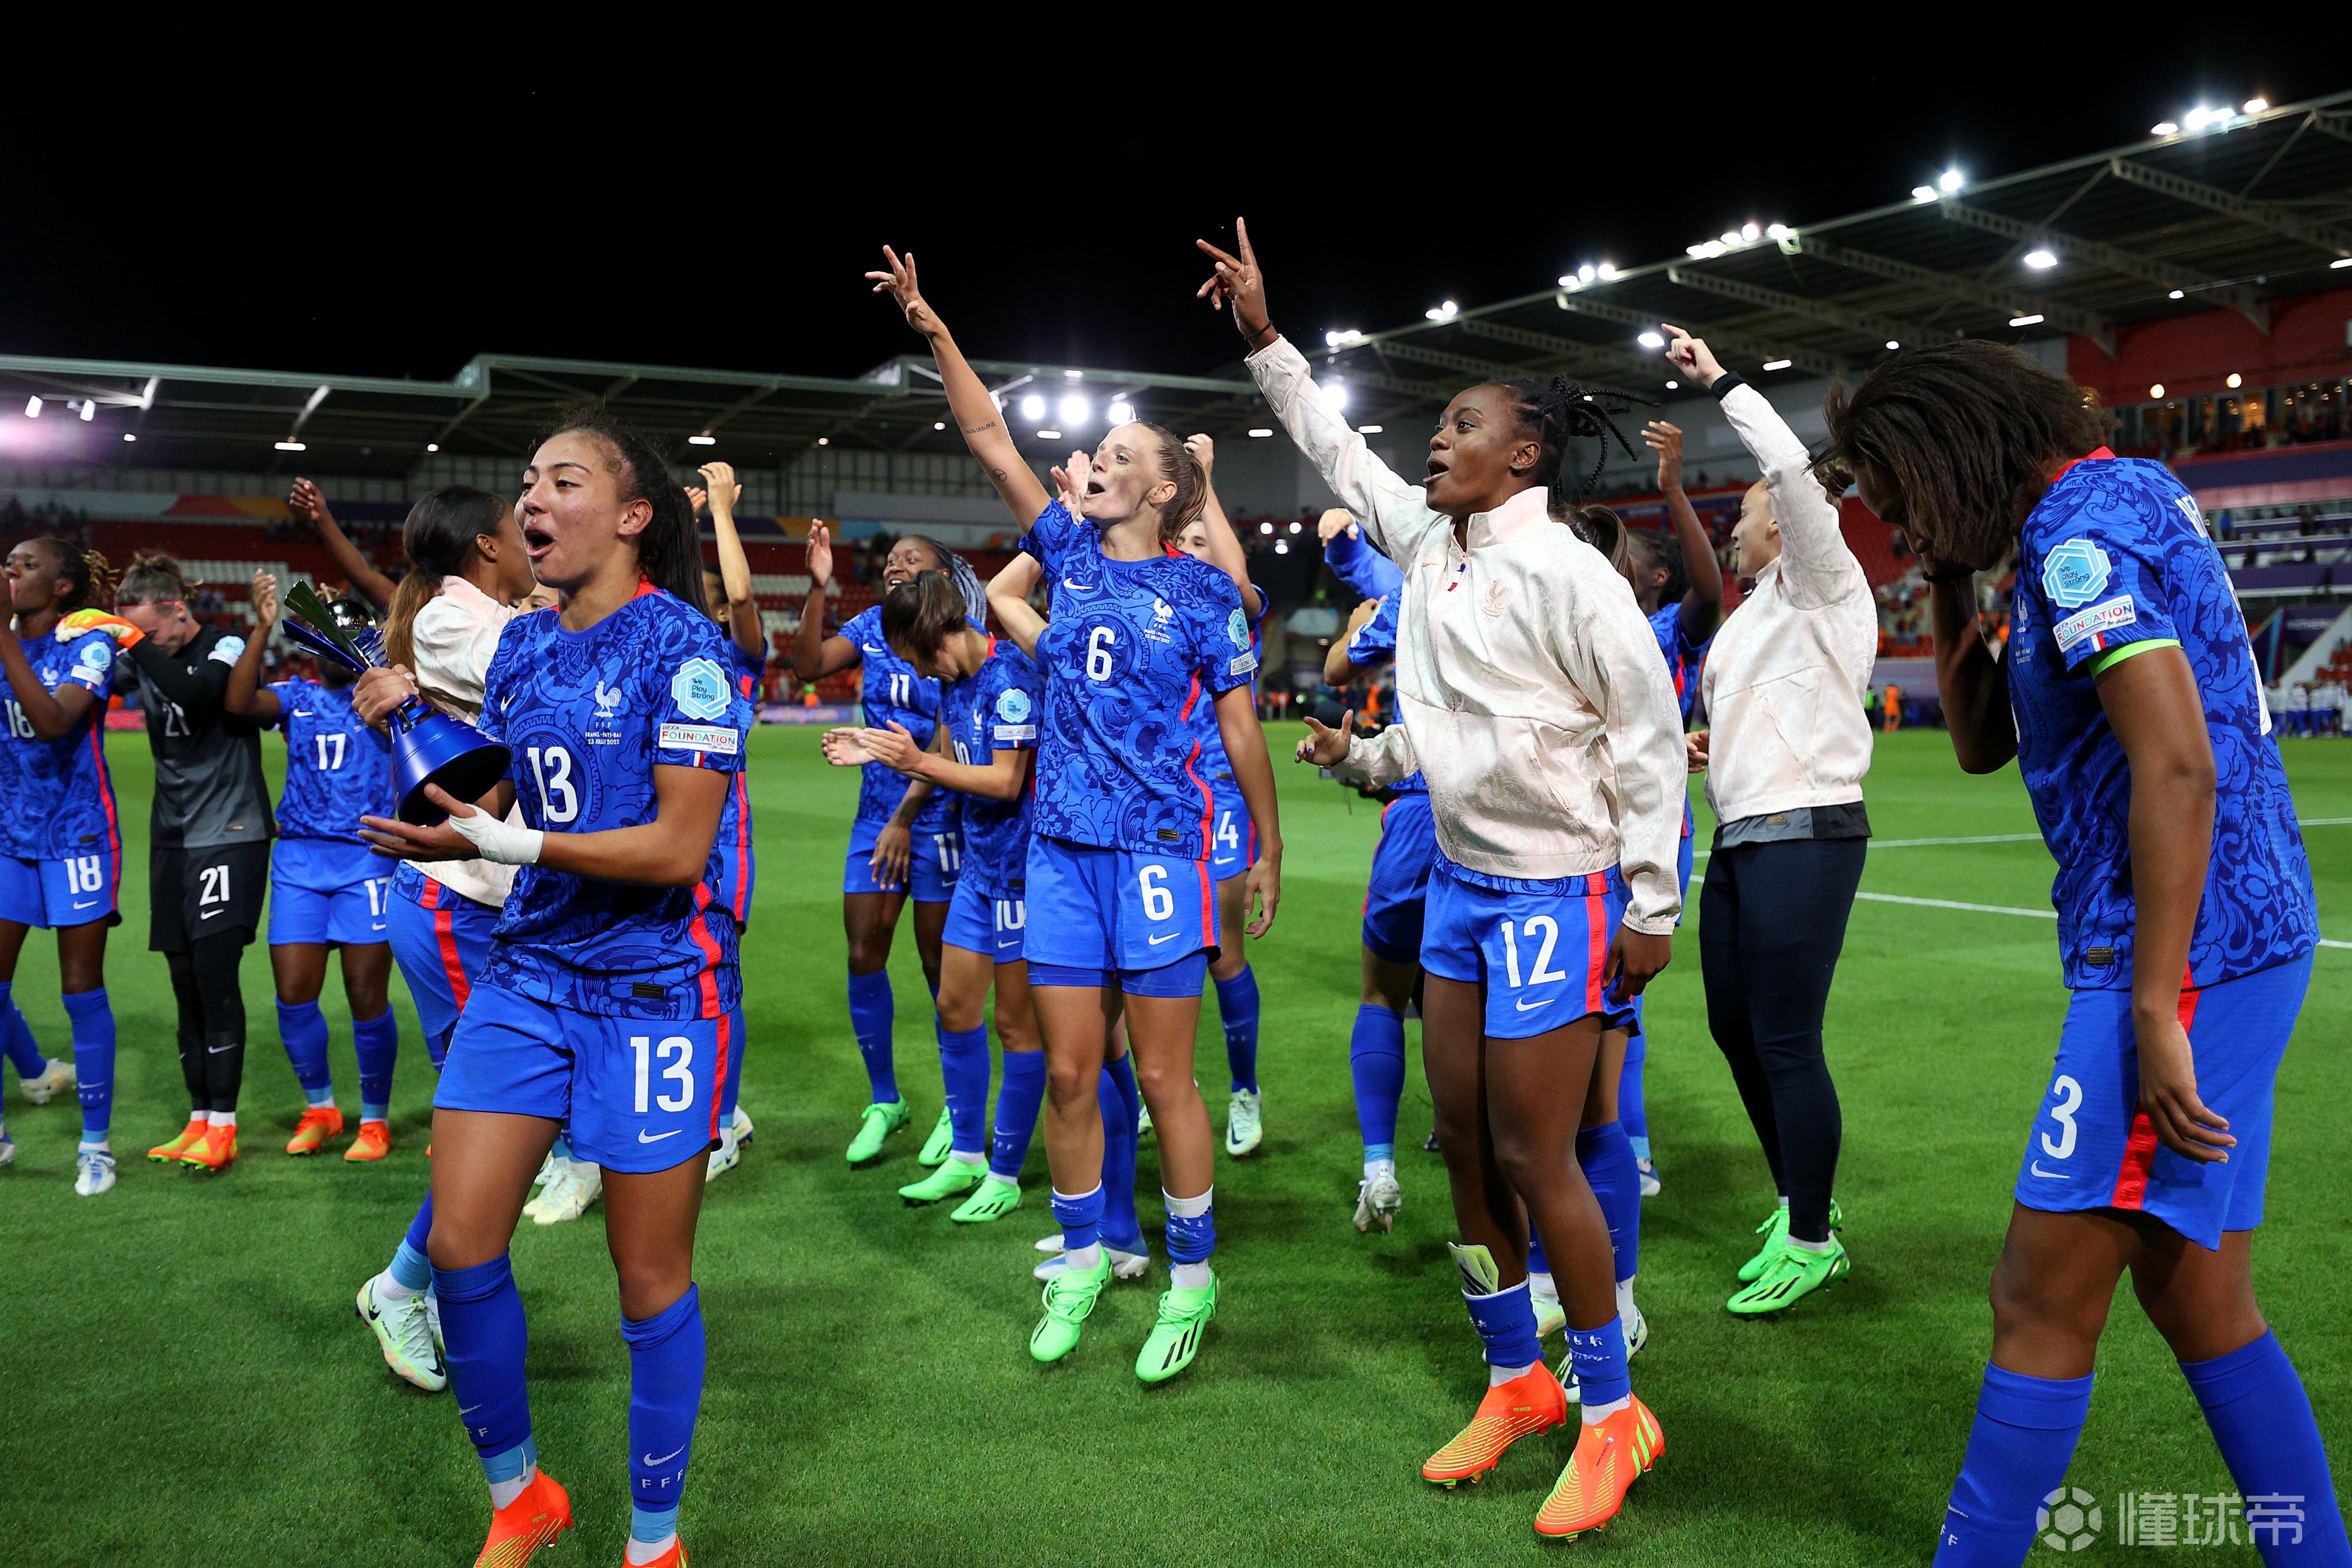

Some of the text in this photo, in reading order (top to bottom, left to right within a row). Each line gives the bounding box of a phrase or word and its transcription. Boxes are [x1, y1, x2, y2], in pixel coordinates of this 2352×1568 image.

[2061, 570, 2079, 580] Play
[2064, 573, 2090, 587] Strong
[2055, 622, 2069, 633] UEFA
[2057, 604, 2133, 643] FOUNDATION
[1086, 626, 1115, 682] 6
[691, 692, 715, 700] Strong
[692, 685, 707, 693] Play
[889, 673, 911, 709] 11
[5, 699, 37, 738] 18
[662, 731, 735, 745] FOUNDATION
[315, 733, 346, 770] 17
[953, 740, 970, 765] 10
[528, 747, 578, 822] 13
[934, 833, 960, 872] 11
[63, 855, 102, 895] 18
[199, 865, 230, 907] 21
[1139, 864, 1174, 921] 6
[363, 877, 390, 916] 17
[996, 900, 1026, 931] 10
[1501, 915, 1566, 988] 12
[630, 1036, 694, 1113] 13
[2041, 1075, 2083, 1159] 3
